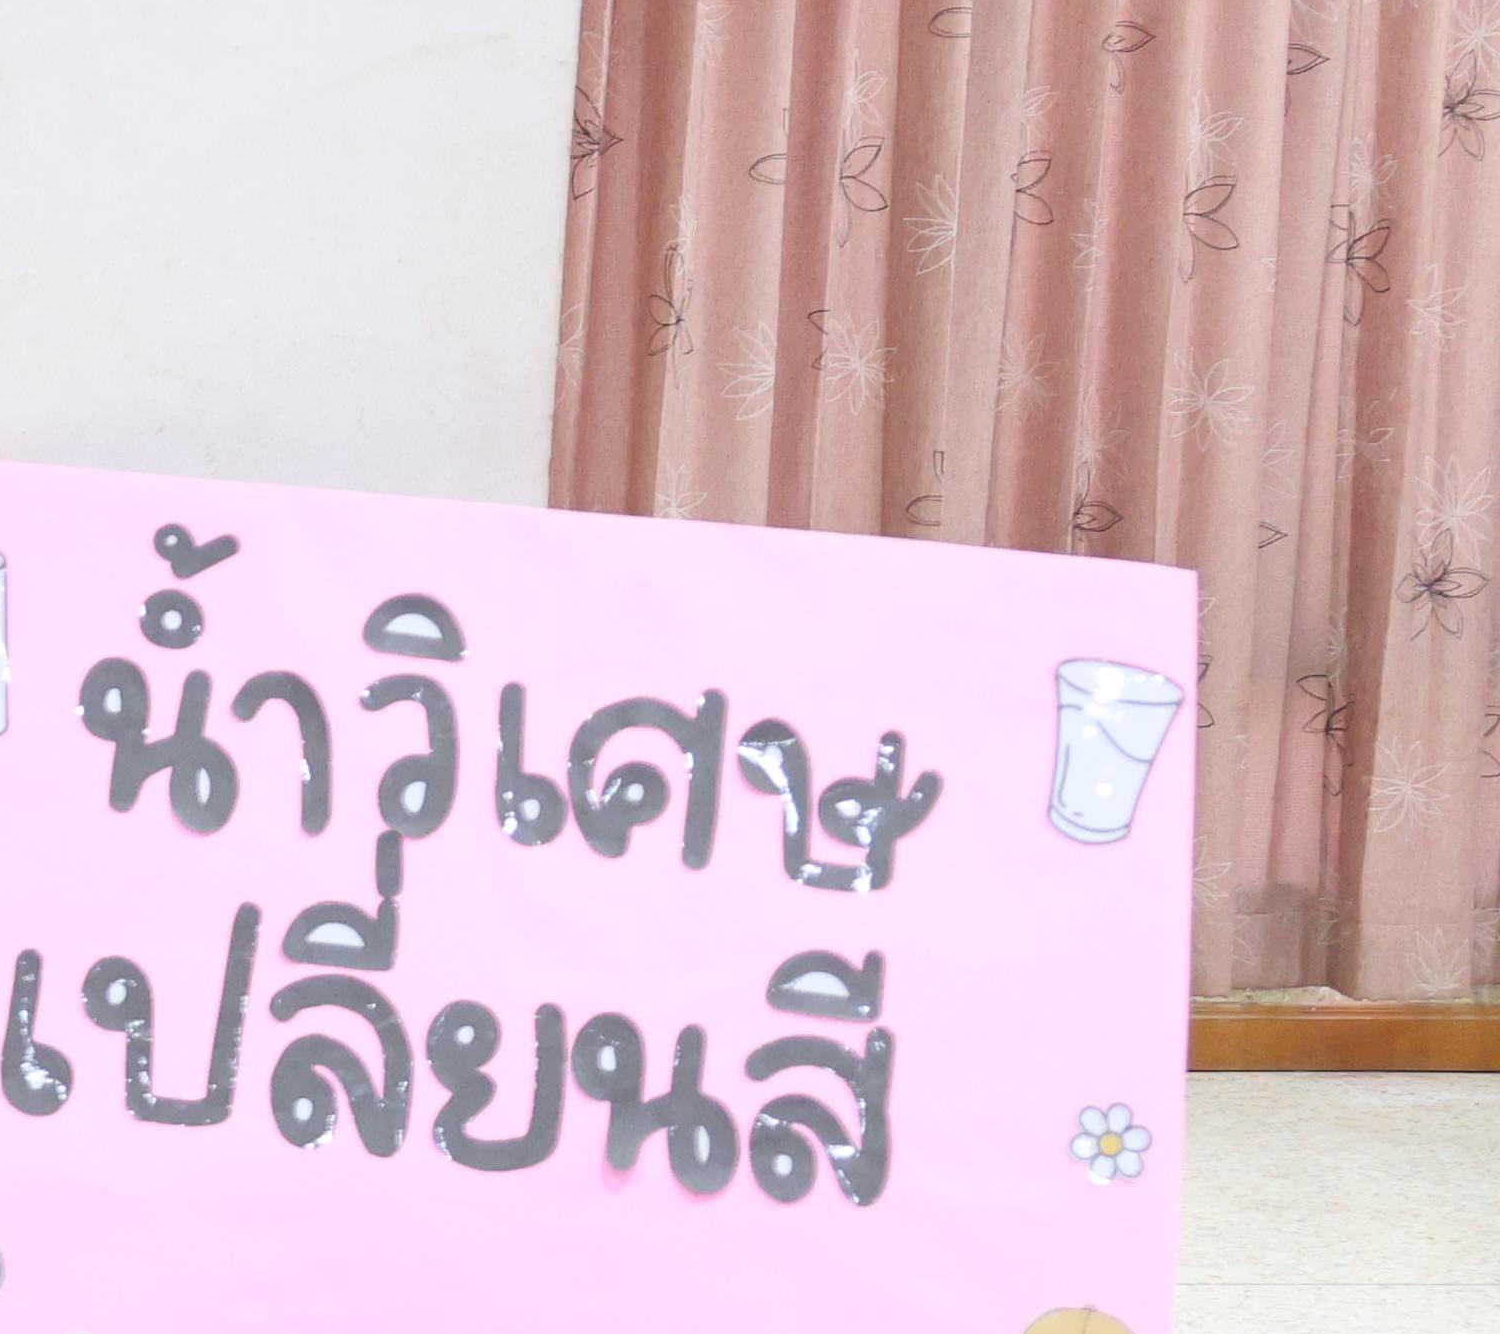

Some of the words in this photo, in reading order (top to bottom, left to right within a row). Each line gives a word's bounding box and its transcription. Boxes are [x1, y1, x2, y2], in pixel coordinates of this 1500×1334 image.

[77, 522, 944, 893] น้ำวิเศษ
[0, 829, 896, 1207] เปลี่ยนสี
